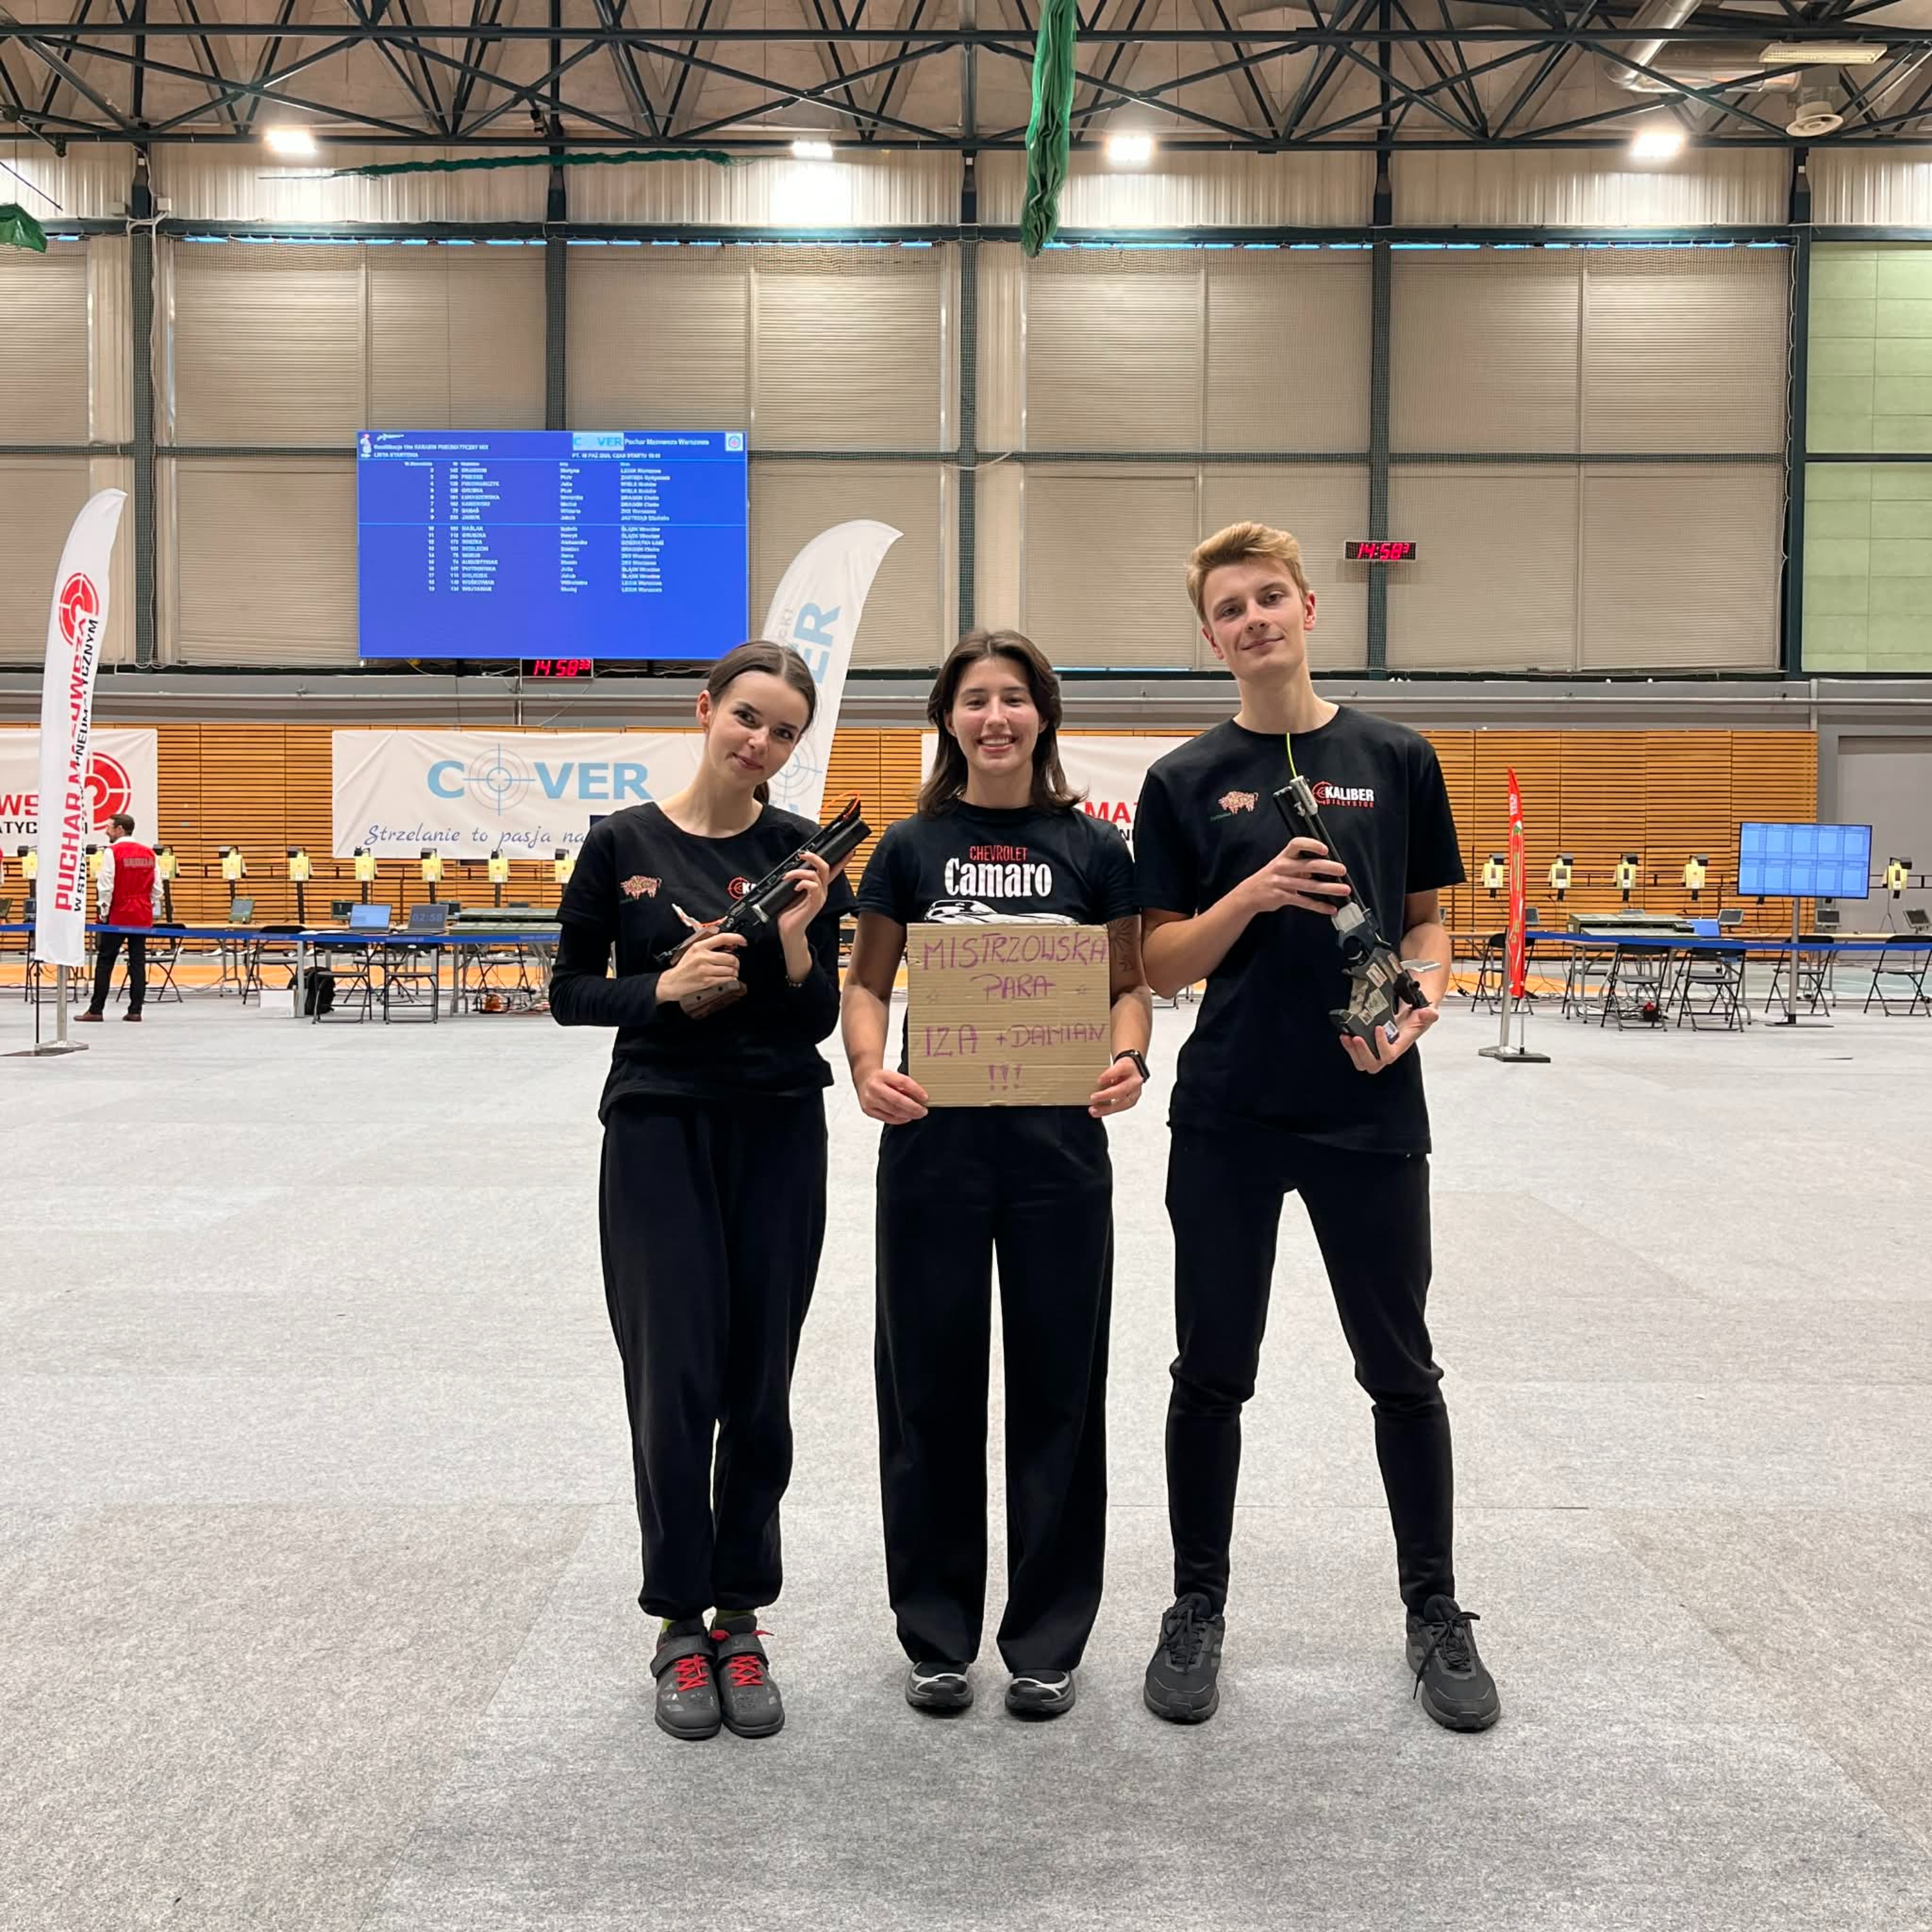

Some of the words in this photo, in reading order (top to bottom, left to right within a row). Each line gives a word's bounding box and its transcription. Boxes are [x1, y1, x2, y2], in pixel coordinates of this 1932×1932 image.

[574, 437, 622, 446] CVER
[1325, 786, 1374, 801] KALIBER
[364, 822, 460, 845] Strzelanie
[472, 828, 488, 842] to
[497, 826, 551, 849] pasja
[969, 845, 1028, 862] CHEVROLET
[944, 857, 1052, 898] Camaro
[923, 931, 1108, 971] MISTRZOWSKA
[970, 973, 1057, 1001] PARA
[923, 1024, 978, 1057] IZA
